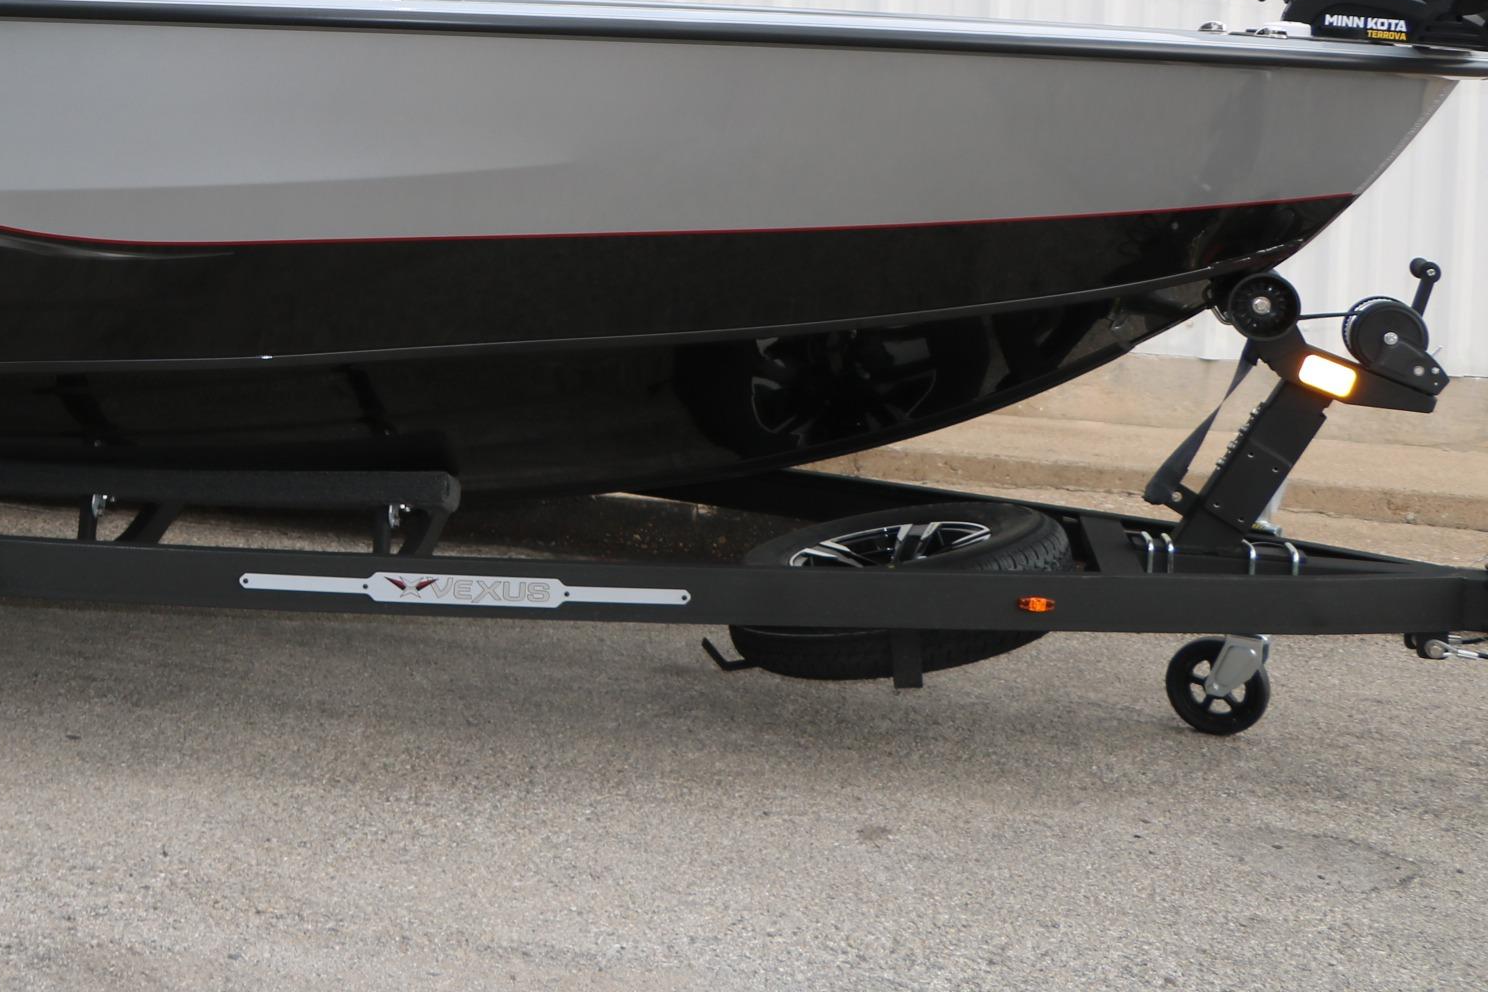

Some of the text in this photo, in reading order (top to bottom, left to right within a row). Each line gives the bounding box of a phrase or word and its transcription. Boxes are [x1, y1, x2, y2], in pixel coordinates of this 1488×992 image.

[1324, 13, 1408, 33] MINN KOTA
[1366, 29, 1407, 41] TERROVA
[428, 575, 551, 604] VEXUS
